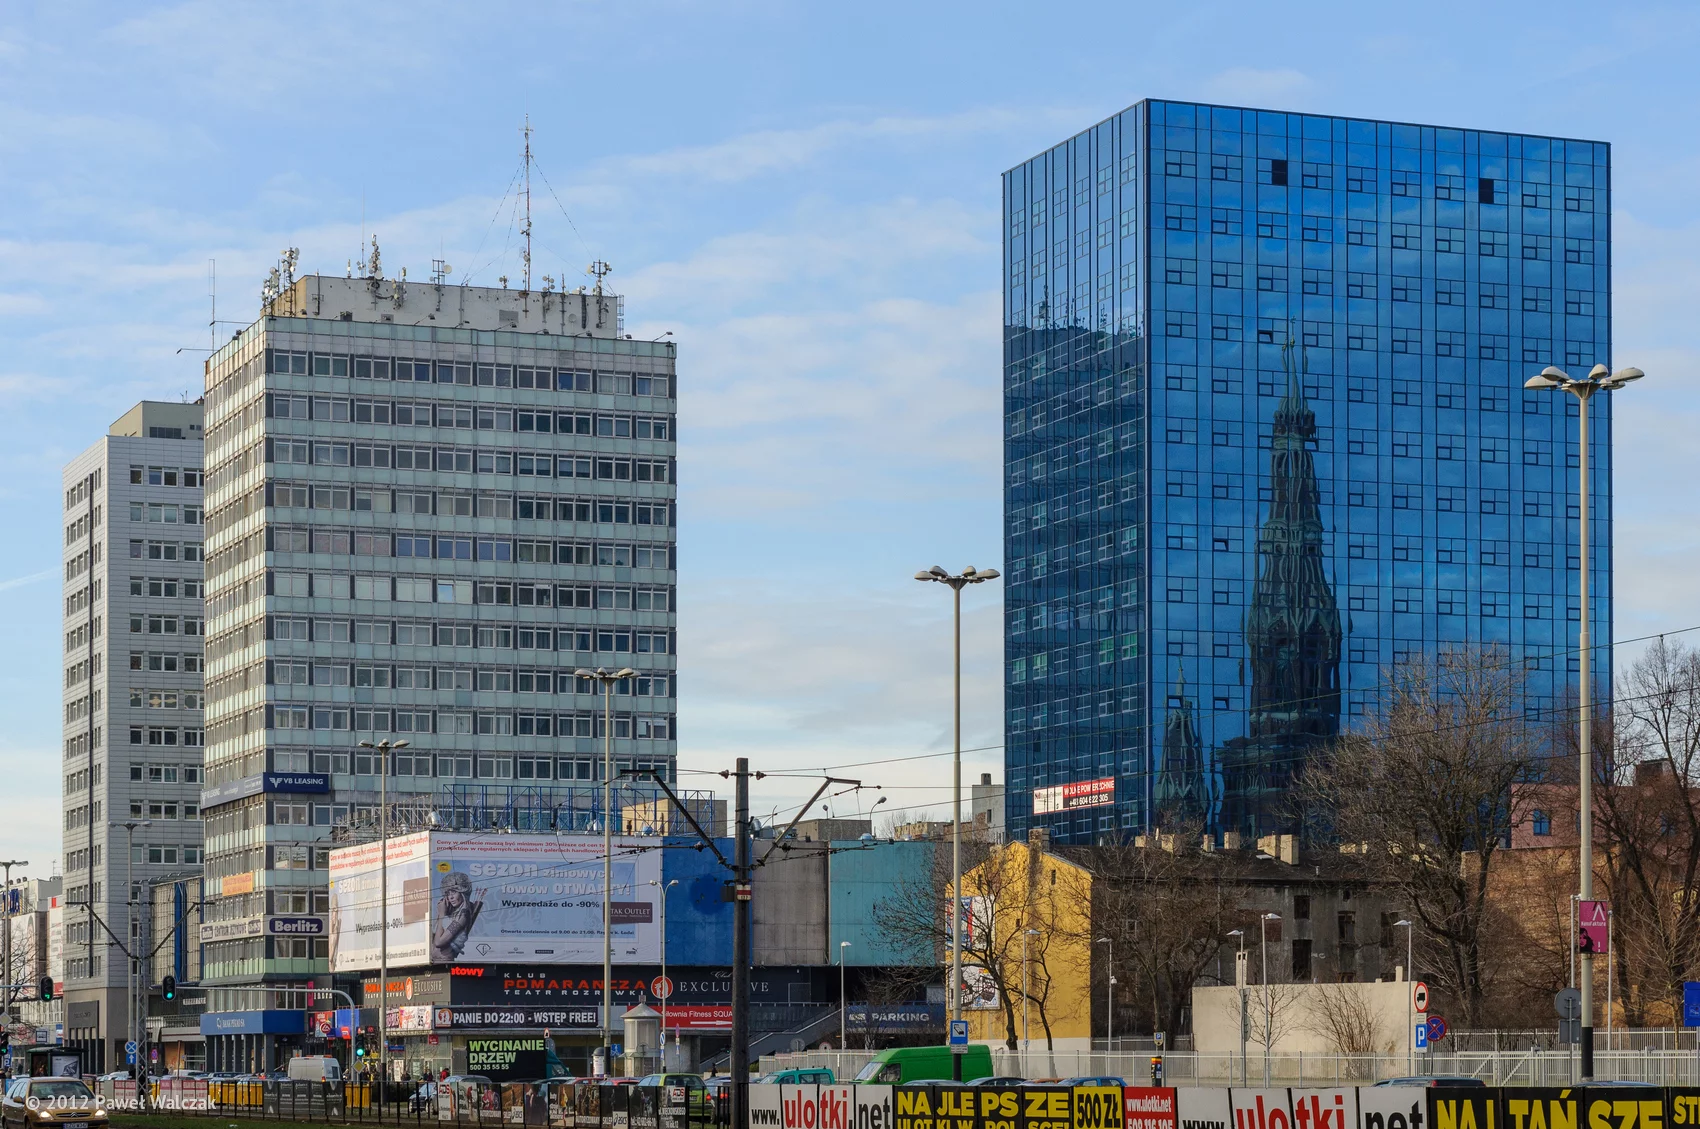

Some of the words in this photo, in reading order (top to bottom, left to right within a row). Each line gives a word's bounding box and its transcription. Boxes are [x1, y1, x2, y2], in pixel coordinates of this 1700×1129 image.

[469, 862, 538, 878] sezon
[502, 900, 558, 909] Wyprzedaże
[274, 920, 318, 932] Berlitz
[414, 981, 442, 992] EXCLUSIVE
[680, 982, 769, 992] EXCLUVE
[453, 1012, 482, 1023] PANIE
[484, 1013, 498, 1023] DO
[500, 1013, 524, 1023] 22:00
[534, 1012, 566, 1025] WSTĘP
[570, 1012, 596, 1023] FREE!
[872, 1013, 930, 1021] PARKING
[1418, 1027, 1424, 1045] P
[469, 1040, 544, 1051] WYCINANIE
[469, 1052, 516, 1064] DRZEW
